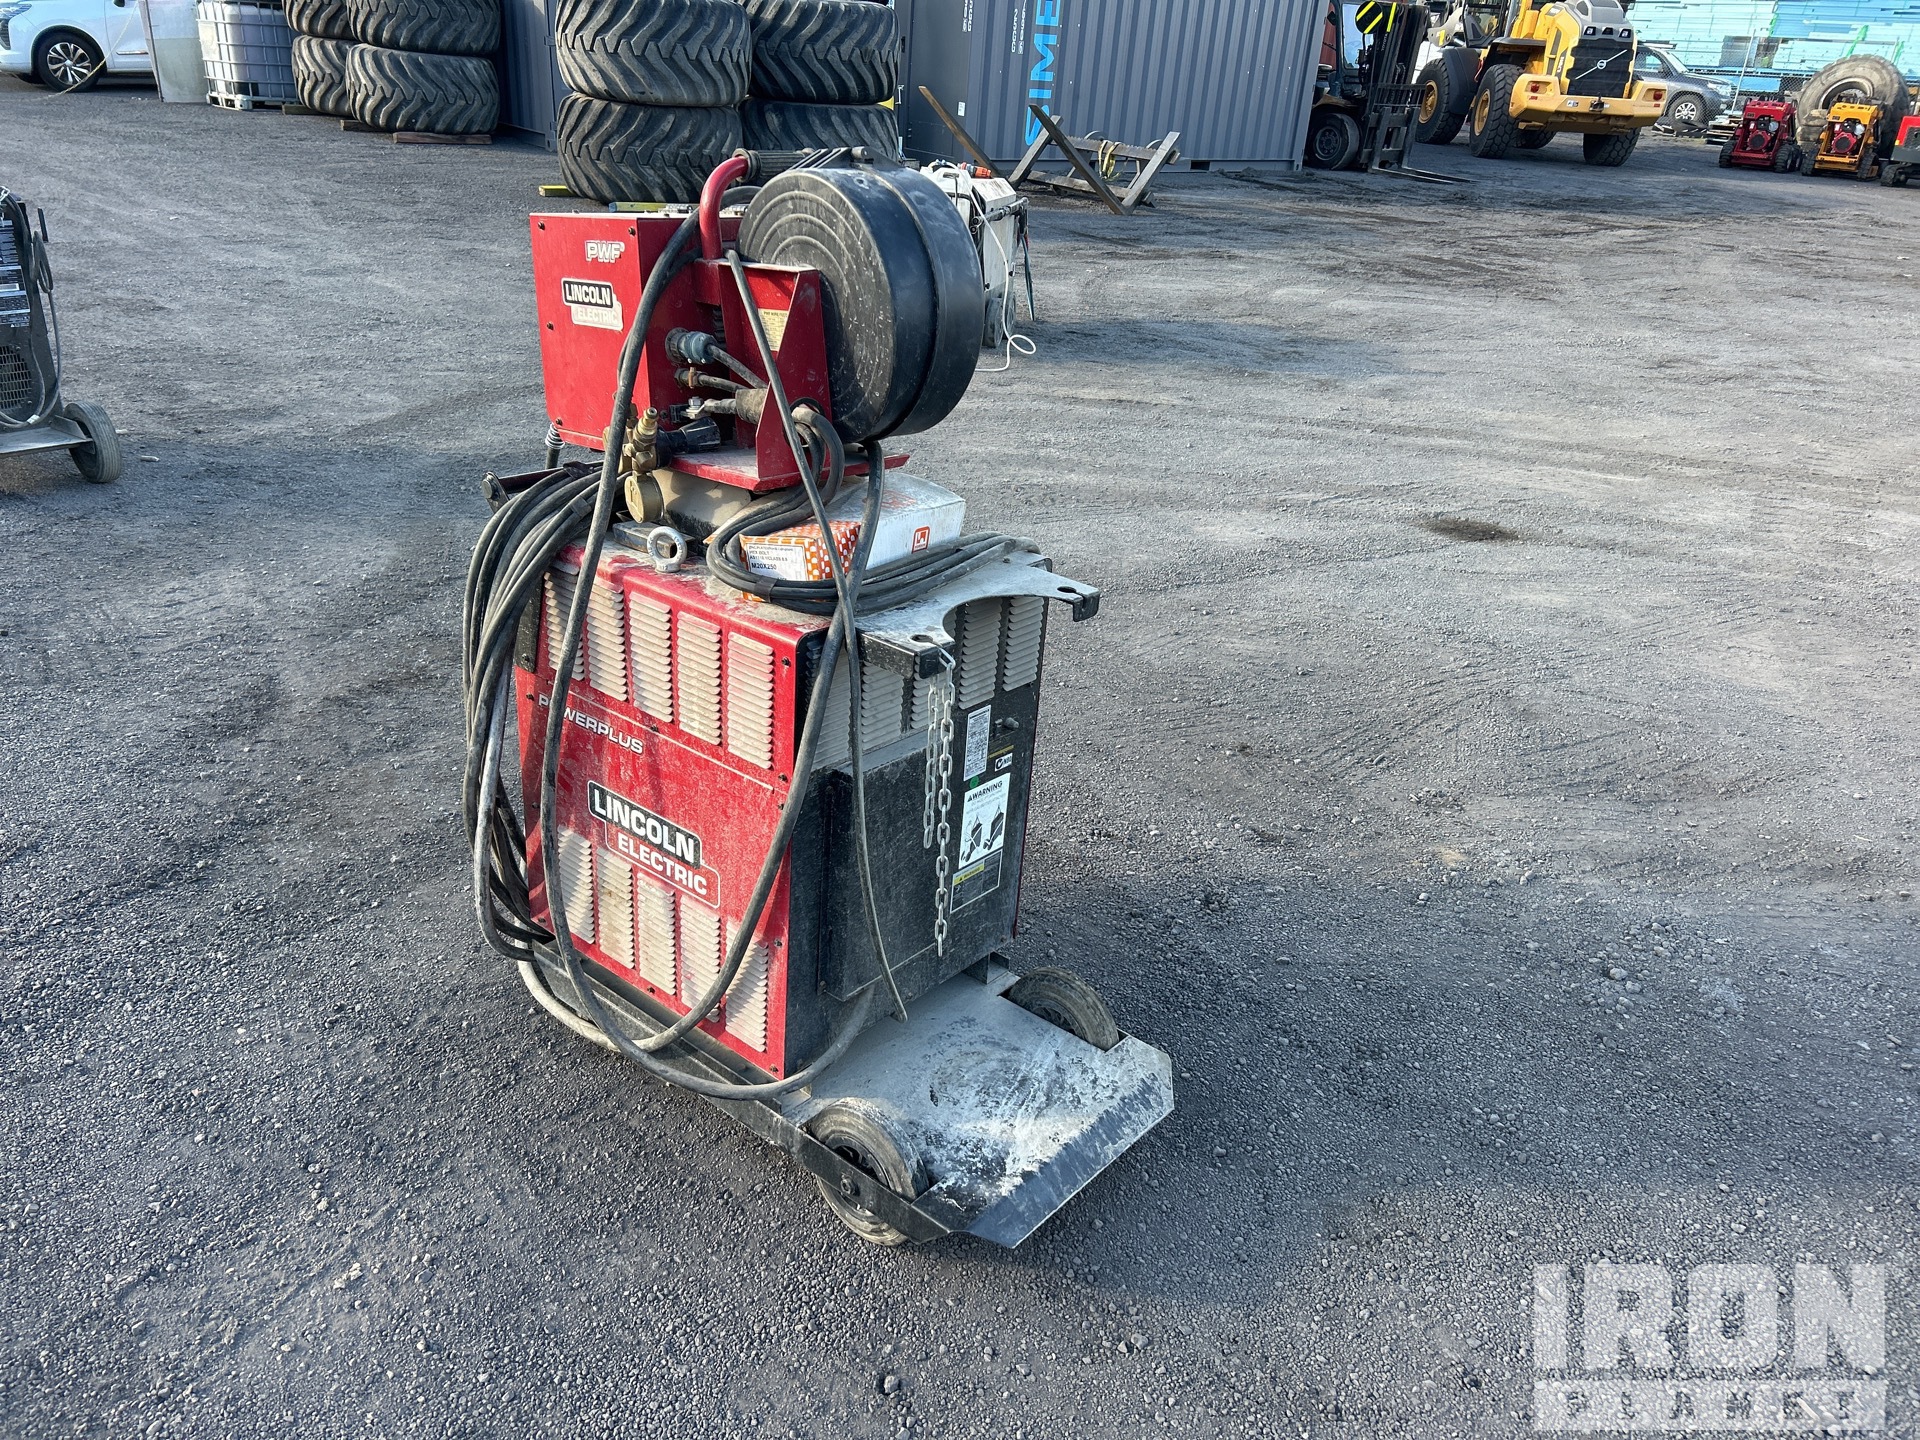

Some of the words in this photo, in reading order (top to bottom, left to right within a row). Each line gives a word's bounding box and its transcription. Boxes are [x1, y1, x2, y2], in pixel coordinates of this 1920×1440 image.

[585, 240, 623, 263] PWF
[564, 283, 612, 306] LINCOLN
[576, 306, 618, 325] ELECTRIC
[752, 563, 777, 571] M20X250
[538, 694, 644, 755] PWERPLUS
[972, 780, 1003, 800] WARNING
[594, 787, 695, 864] LINCOLN
[617, 831, 708, 896] ELECTRIC
